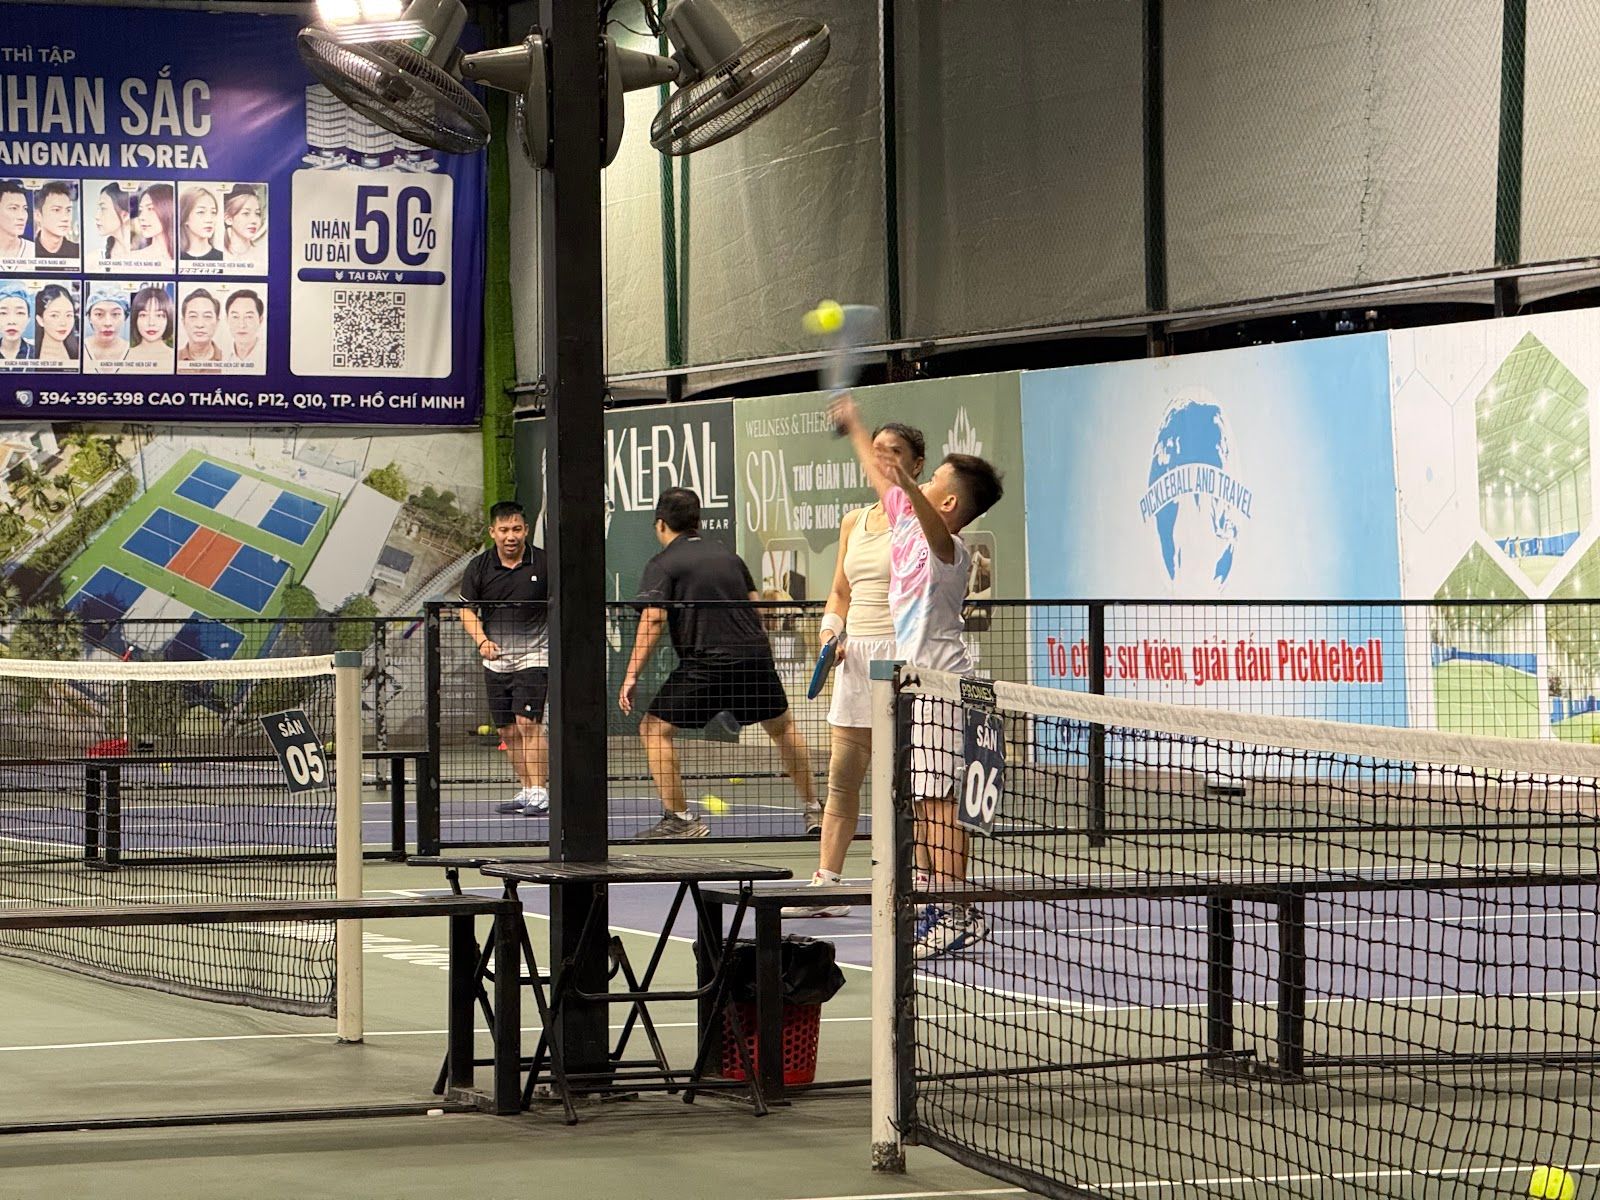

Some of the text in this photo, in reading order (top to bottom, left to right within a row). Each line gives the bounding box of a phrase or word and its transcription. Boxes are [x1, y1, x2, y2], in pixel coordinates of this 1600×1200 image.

[38, 46, 76, 66] TẬP
[0, 65, 212, 137] HAN SẮC
[0, 141, 208, 169] ANGNAM KOREA
[348, 271, 390, 282] TẠI ĐÂY
[39, 388, 465, 410] 394-396-398 CAO THẮNG, P12, Q10, TP. HỒ CHÍ MINH
[745, 411, 837, 438] WELLNESS & THERA
[604, 421, 728, 511] KLEBALL
[792, 461, 814, 491] THƯ
[842, 458, 857, 489] VÀ
[746, 449, 791, 532] SPA
[1139, 466, 1252, 524] PICKLEBALL AND TRAVEL
[701, 519, 729, 530] WEAR
[793, 502, 813, 530] SỨC
[1071, 638, 1113, 678] chc
[1117, 640, 1139, 687] sự
[1193, 635, 1229, 686] giải
[1234, 632, 1272, 681] đấu
[1277, 639, 1384, 683] Pickleball
[286, 742, 324, 786] 05
[965, 760, 998, 823] 06
